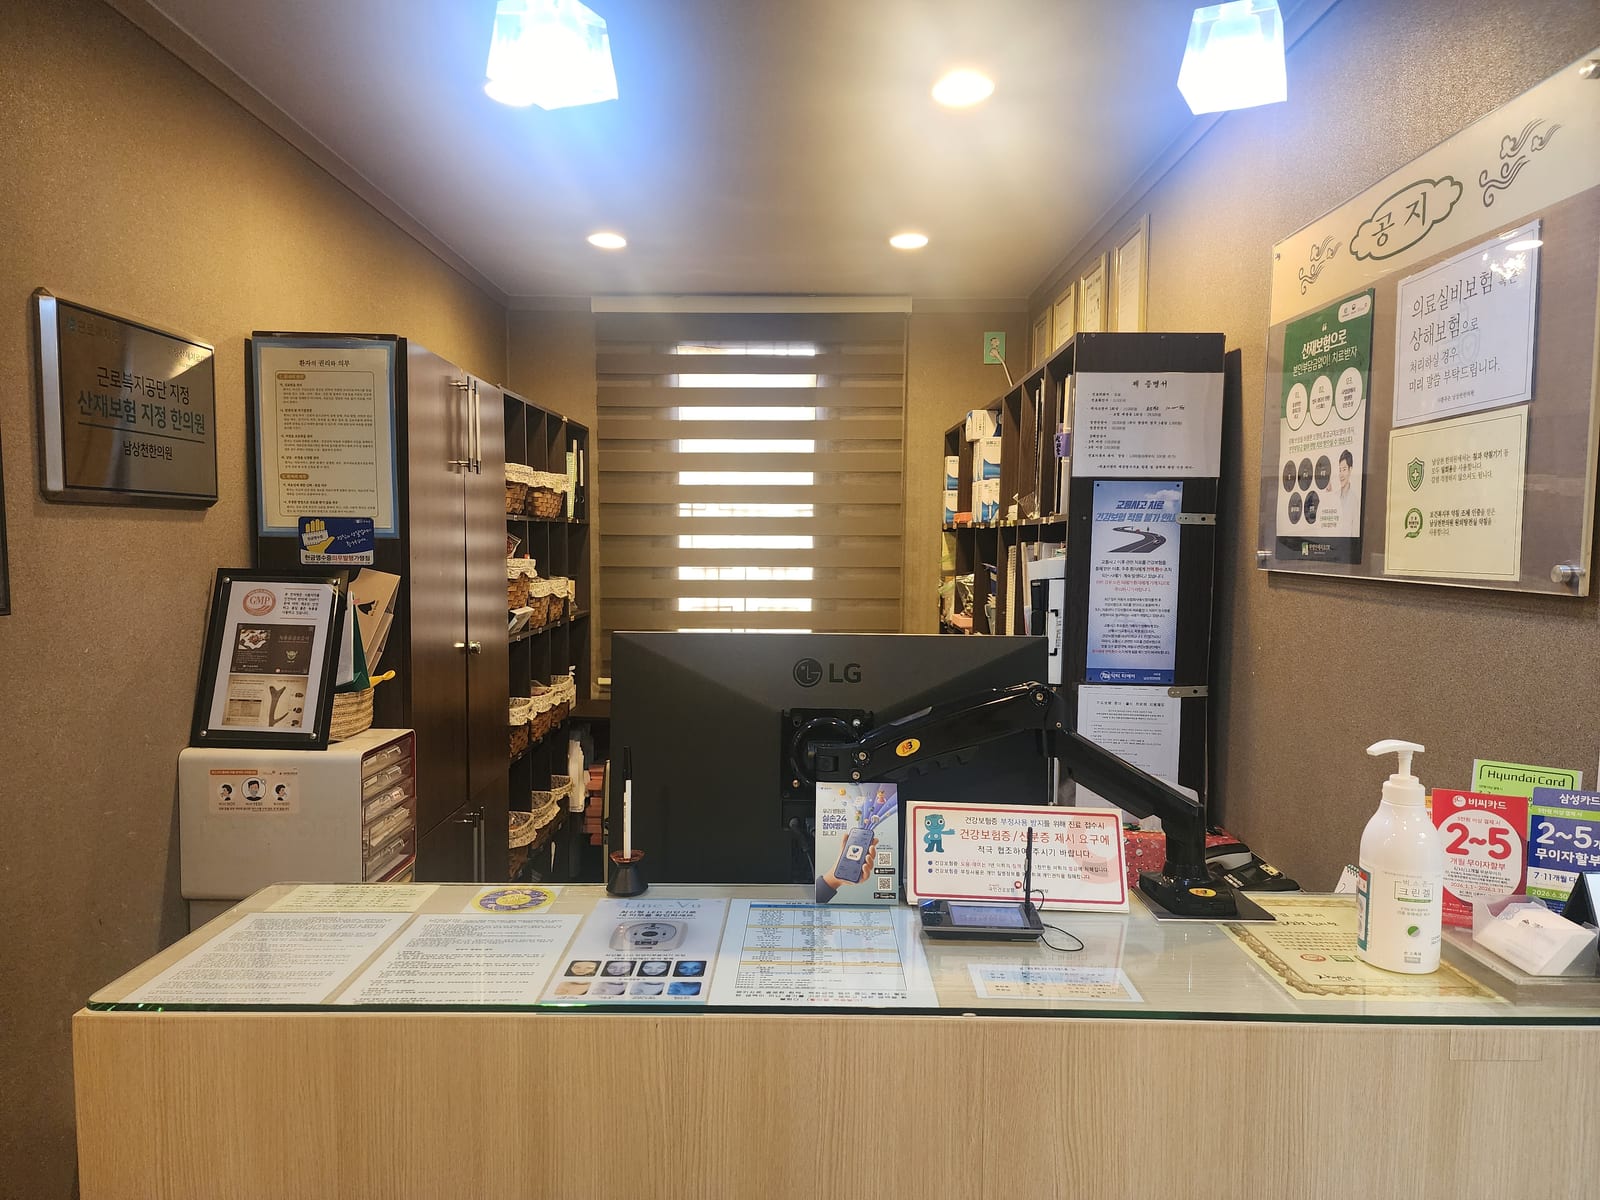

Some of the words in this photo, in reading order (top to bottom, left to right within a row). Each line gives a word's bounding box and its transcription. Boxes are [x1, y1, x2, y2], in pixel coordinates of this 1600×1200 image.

[1411, 270, 1493, 320] 의료실비보험
[1409, 312, 1479, 352] 상해보험으로
[1301, 328, 1348, 360] 산재보험으로
[1332, 345, 1358, 364] 치료받자
[1410, 356, 1440, 374] 처리하실
[1441, 347, 1458, 364] 경우
[298, 359, 317, 367] 환자의
[319, 359, 337, 368] 권리와
[1408, 376, 1424, 393] 미리
[1426, 371, 1441, 389] 말씀
[1443, 356, 1501, 383] 부탁드립니다.
[96, 366, 167, 400] 근로복지공단
[169, 384, 190, 406] 지정
[1145, 379, 1168, 389] 증명서
[77, 389, 136, 425] 산재보험
[141, 403, 167, 429] 지정
[169, 408, 206, 436] 한의원
[122, 440, 173, 461] 남상천한의원
[1472, 451, 1482, 460] 침과
[1115, 500, 1146, 510] 교통사고
[1147, 500, 1165, 510] 치료
[249, 596, 271, 606] GMP
[828, 663, 862, 683] LG
[1487, 770, 1536, 784] Hyundai
[1537, 778, 1565, 787] Card
[1468, 798, 1507, 810] 비씨카드
[1560, 793, 1600, 806] 삼성카드
[822, 814, 848, 822] 실손24
[965, 816, 998, 826] 건강보험증
[1000, 818, 1028, 827] 부정사용
[1029, 818, 1050, 828] 방지를
[1053, 820, 1066, 829] 위해
[1068, 820, 1082, 830] 진료
[1084, 821, 1105, 831] 접수시
[1054, 832, 1076, 845] 제시
[1078, 833, 1110, 846] 요구에
[1446, 823, 1512, 860] 2~5
[977, 845, 993, 855] 적극
[1032, 846, 1056, 857] 주시기
[1059, 847, 1093, 859] 바랍니다.
[1535, 848, 1600, 867] 무이자할부
[1450, 857, 1465, 866] 개월
[1467, 859, 1506, 870] 무이자할부
[1399, 887, 1431, 898] 크린겔
